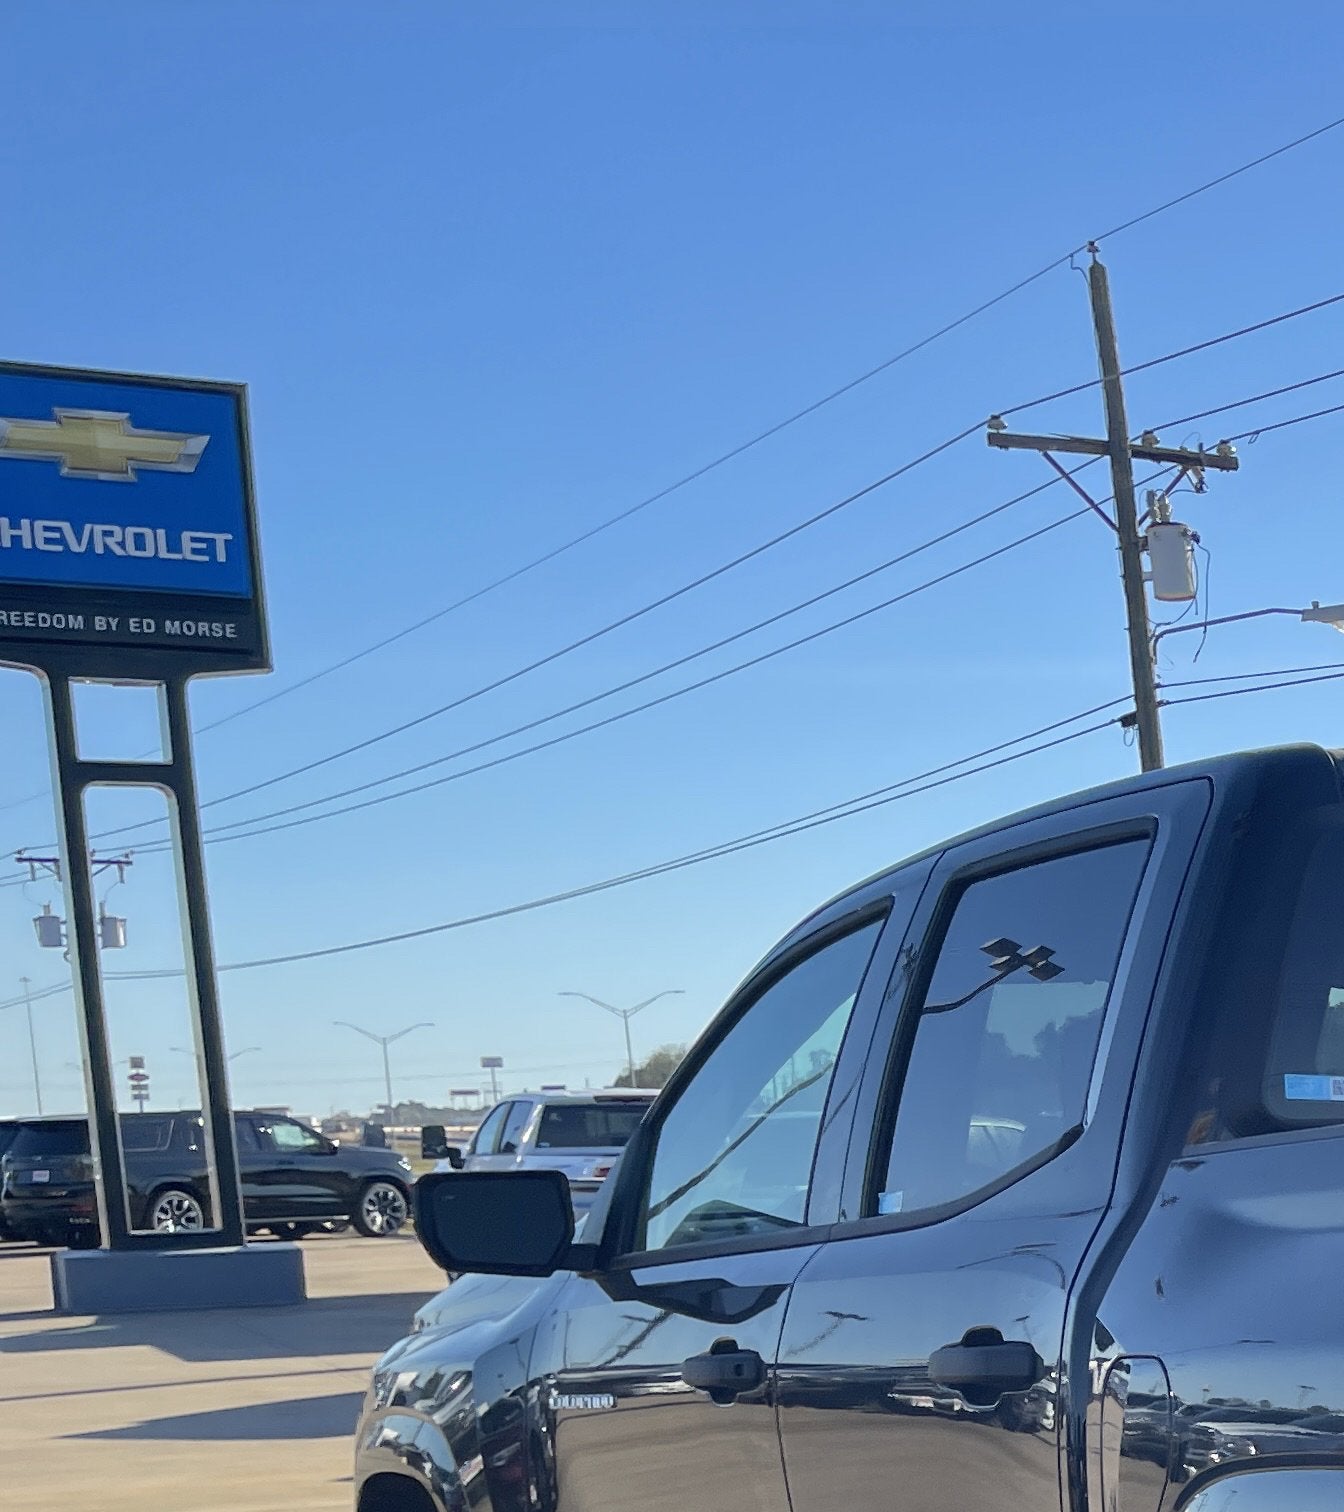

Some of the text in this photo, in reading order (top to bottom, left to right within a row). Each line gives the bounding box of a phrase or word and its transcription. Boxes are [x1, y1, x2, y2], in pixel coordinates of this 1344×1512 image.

[0, 516, 233, 563] HEVROLET
[0, 610, 237, 638] REEDOM BY ED MORSE
